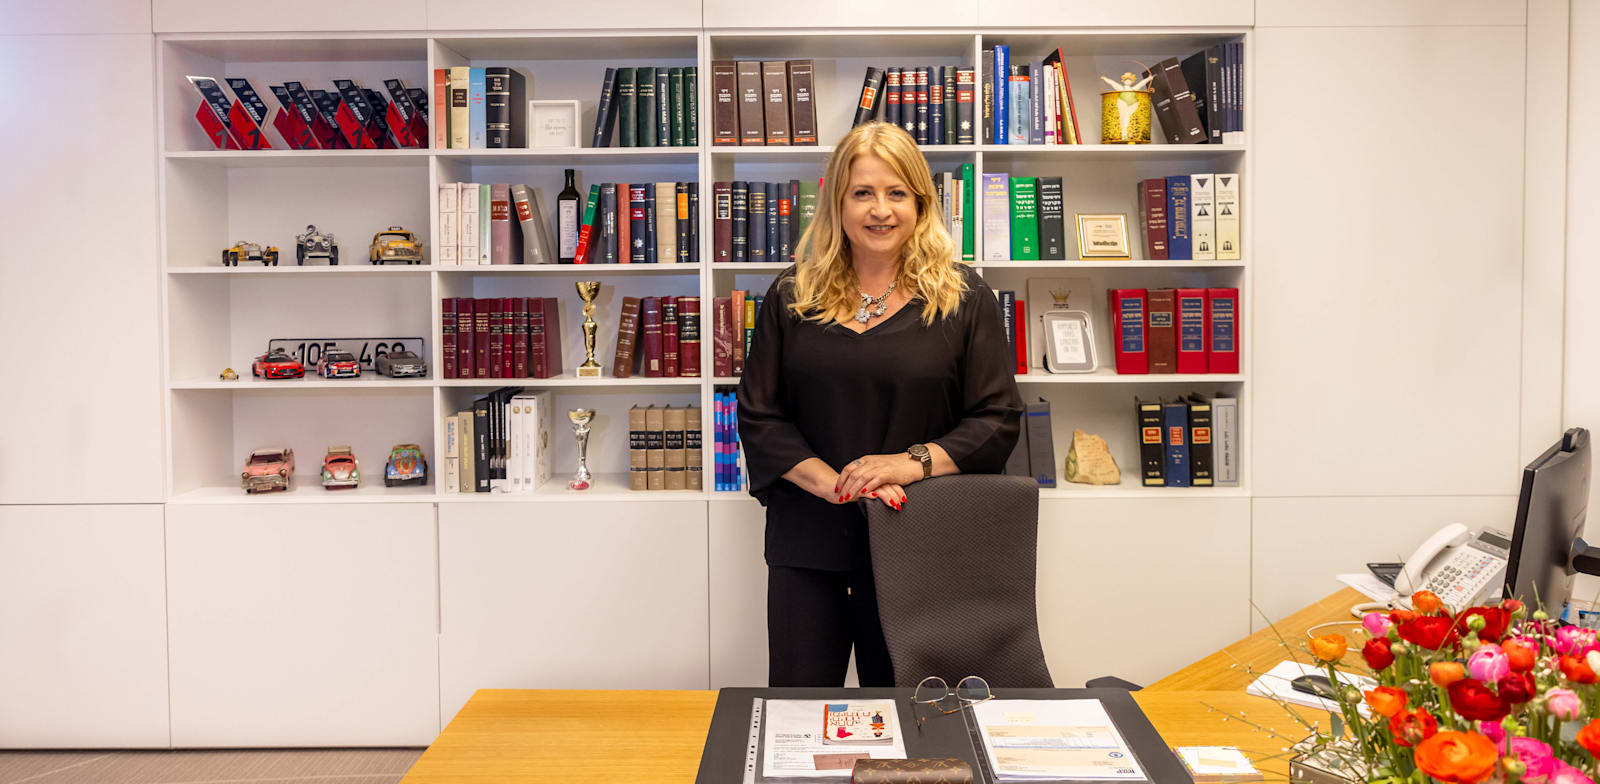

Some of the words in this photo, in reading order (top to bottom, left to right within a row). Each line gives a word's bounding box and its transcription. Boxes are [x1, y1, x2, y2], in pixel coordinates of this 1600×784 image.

[247, 128, 261, 149] 1
[301, 129, 313, 148] 2
[351, 128, 363, 149] 1
[400, 128, 410, 147] 3
